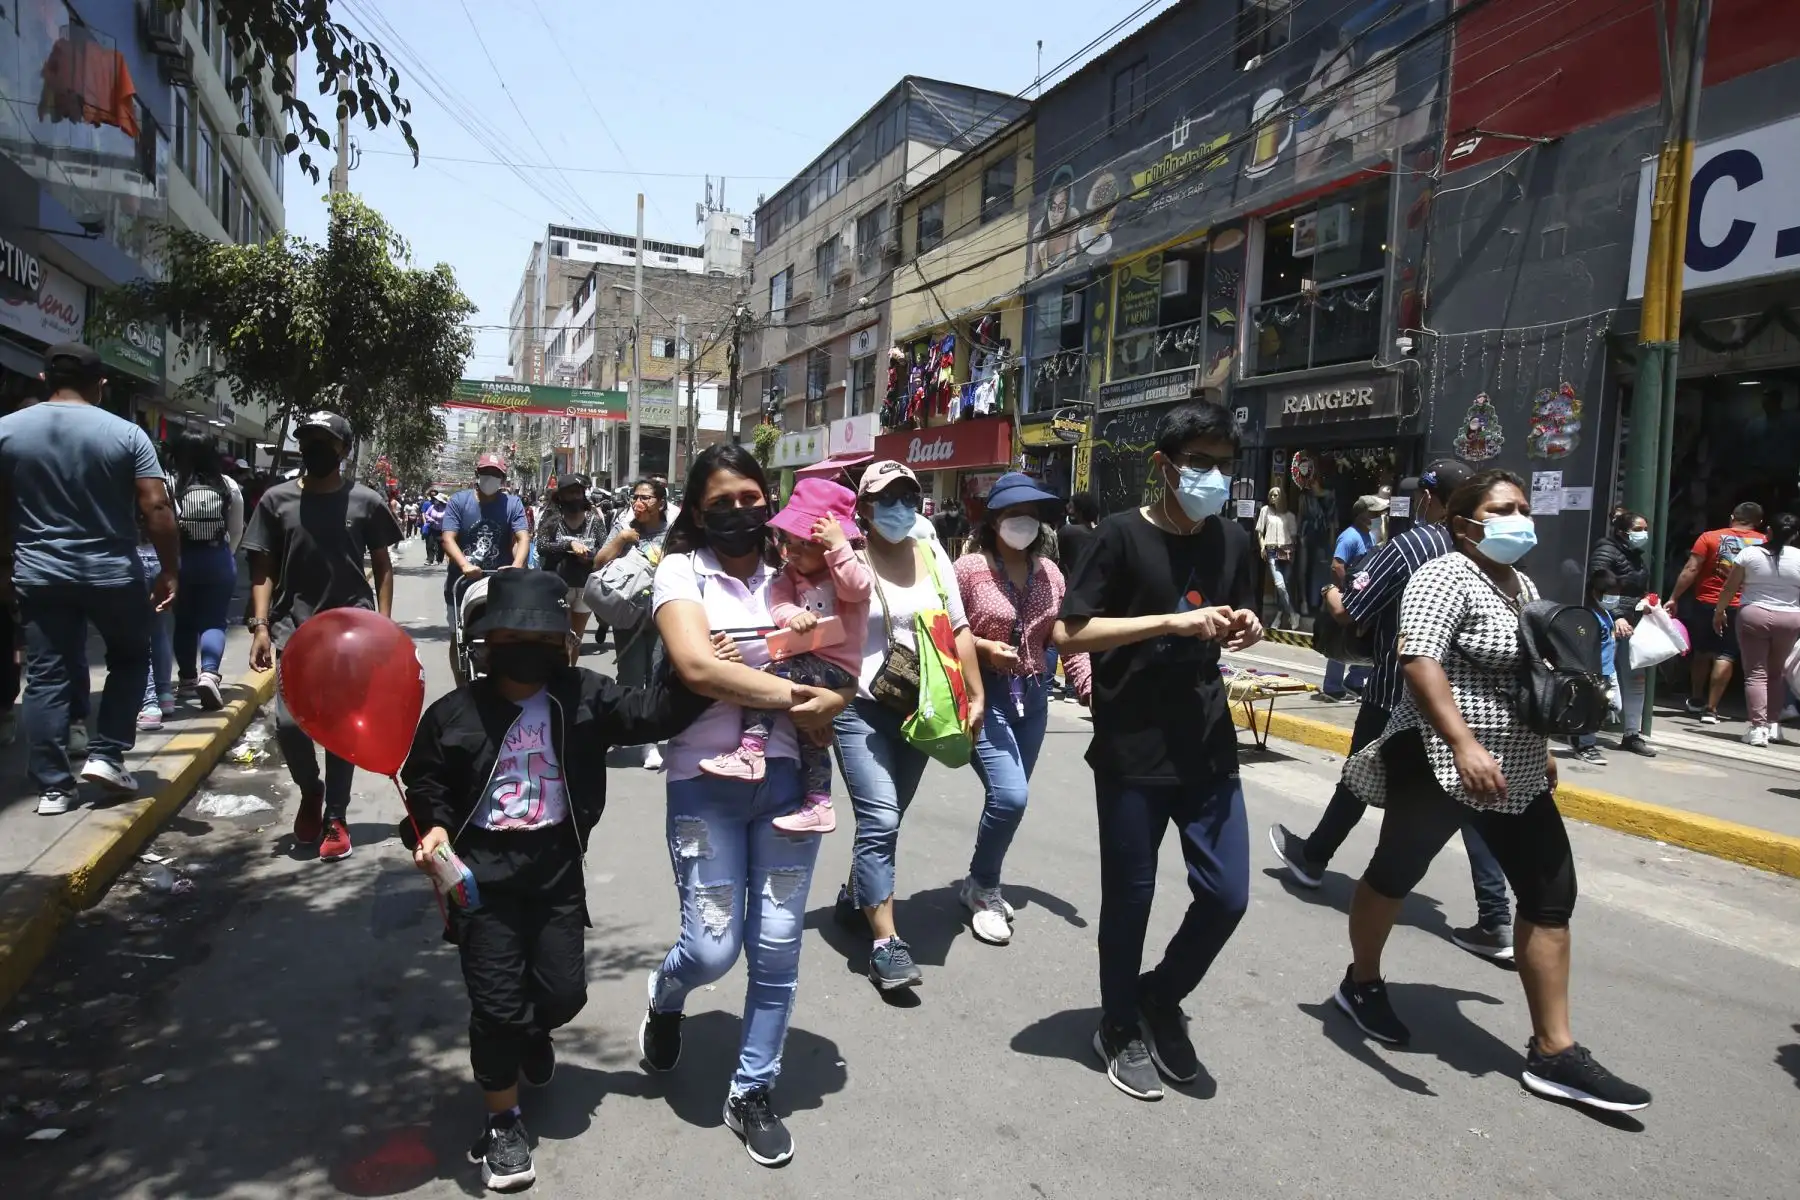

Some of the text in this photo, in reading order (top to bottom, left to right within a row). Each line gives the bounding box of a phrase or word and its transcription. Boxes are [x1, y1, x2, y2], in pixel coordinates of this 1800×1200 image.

[1282, 387, 1374, 414] RANGER
[1236, 410, 1247, 419] Fi
[906, 436, 954, 463] Bata
